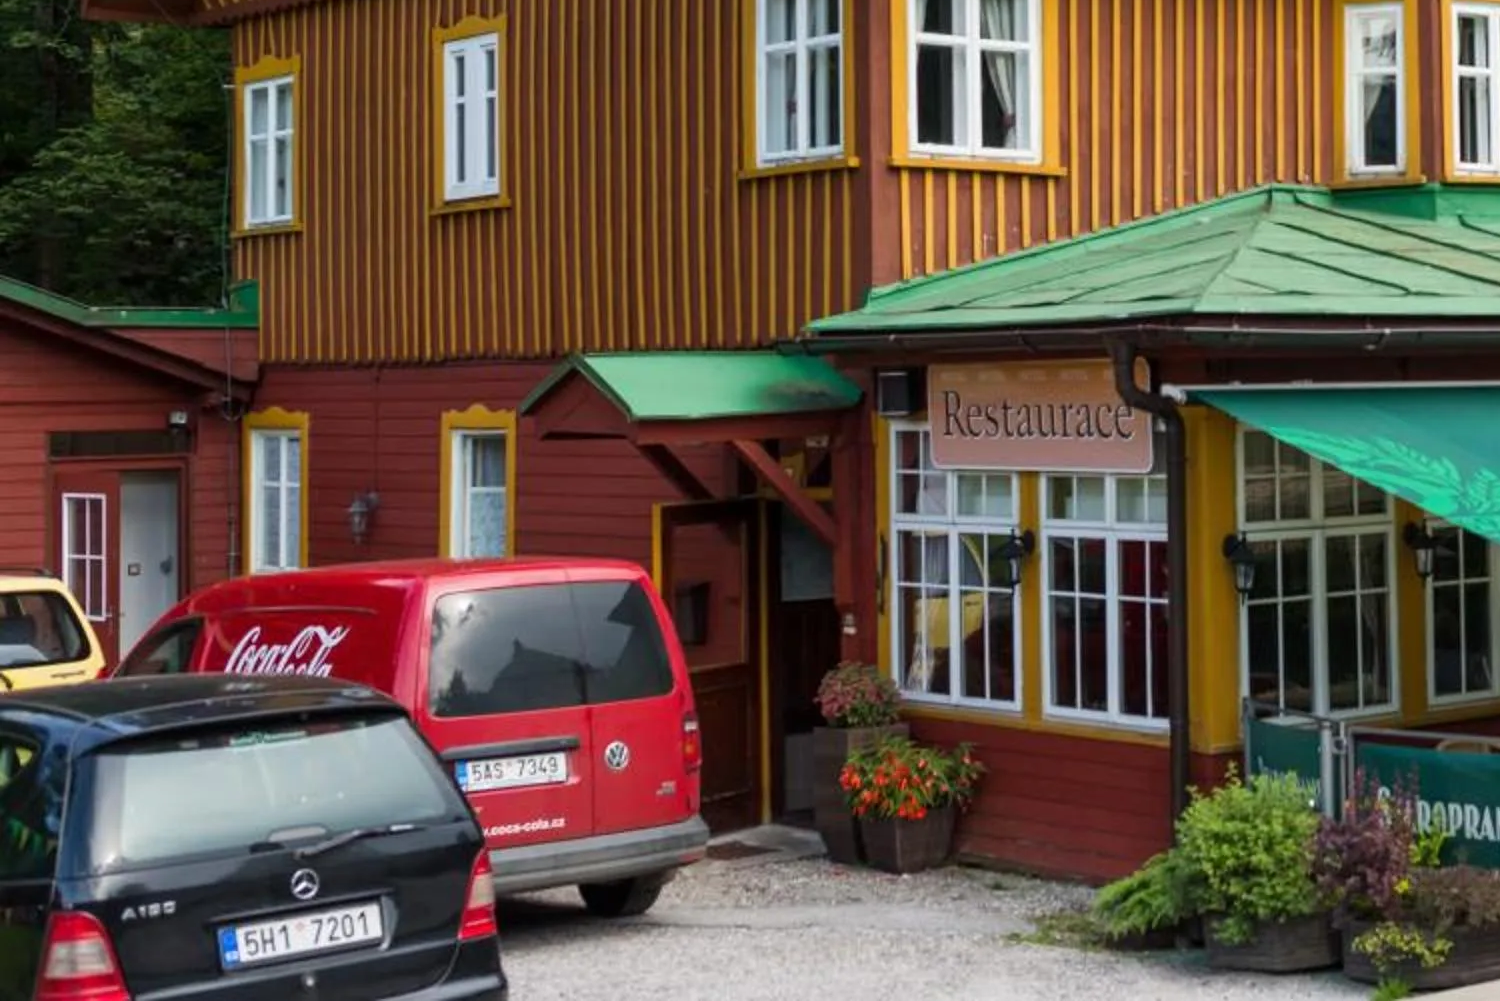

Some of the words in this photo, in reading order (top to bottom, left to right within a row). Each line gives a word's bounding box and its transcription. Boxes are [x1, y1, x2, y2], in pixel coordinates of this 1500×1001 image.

[942, 389, 1135, 440] Restaurace
[517, 756, 559, 776] 7349
[243, 925, 290, 957] 5H1
[310, 911, 370, 946] 7201
